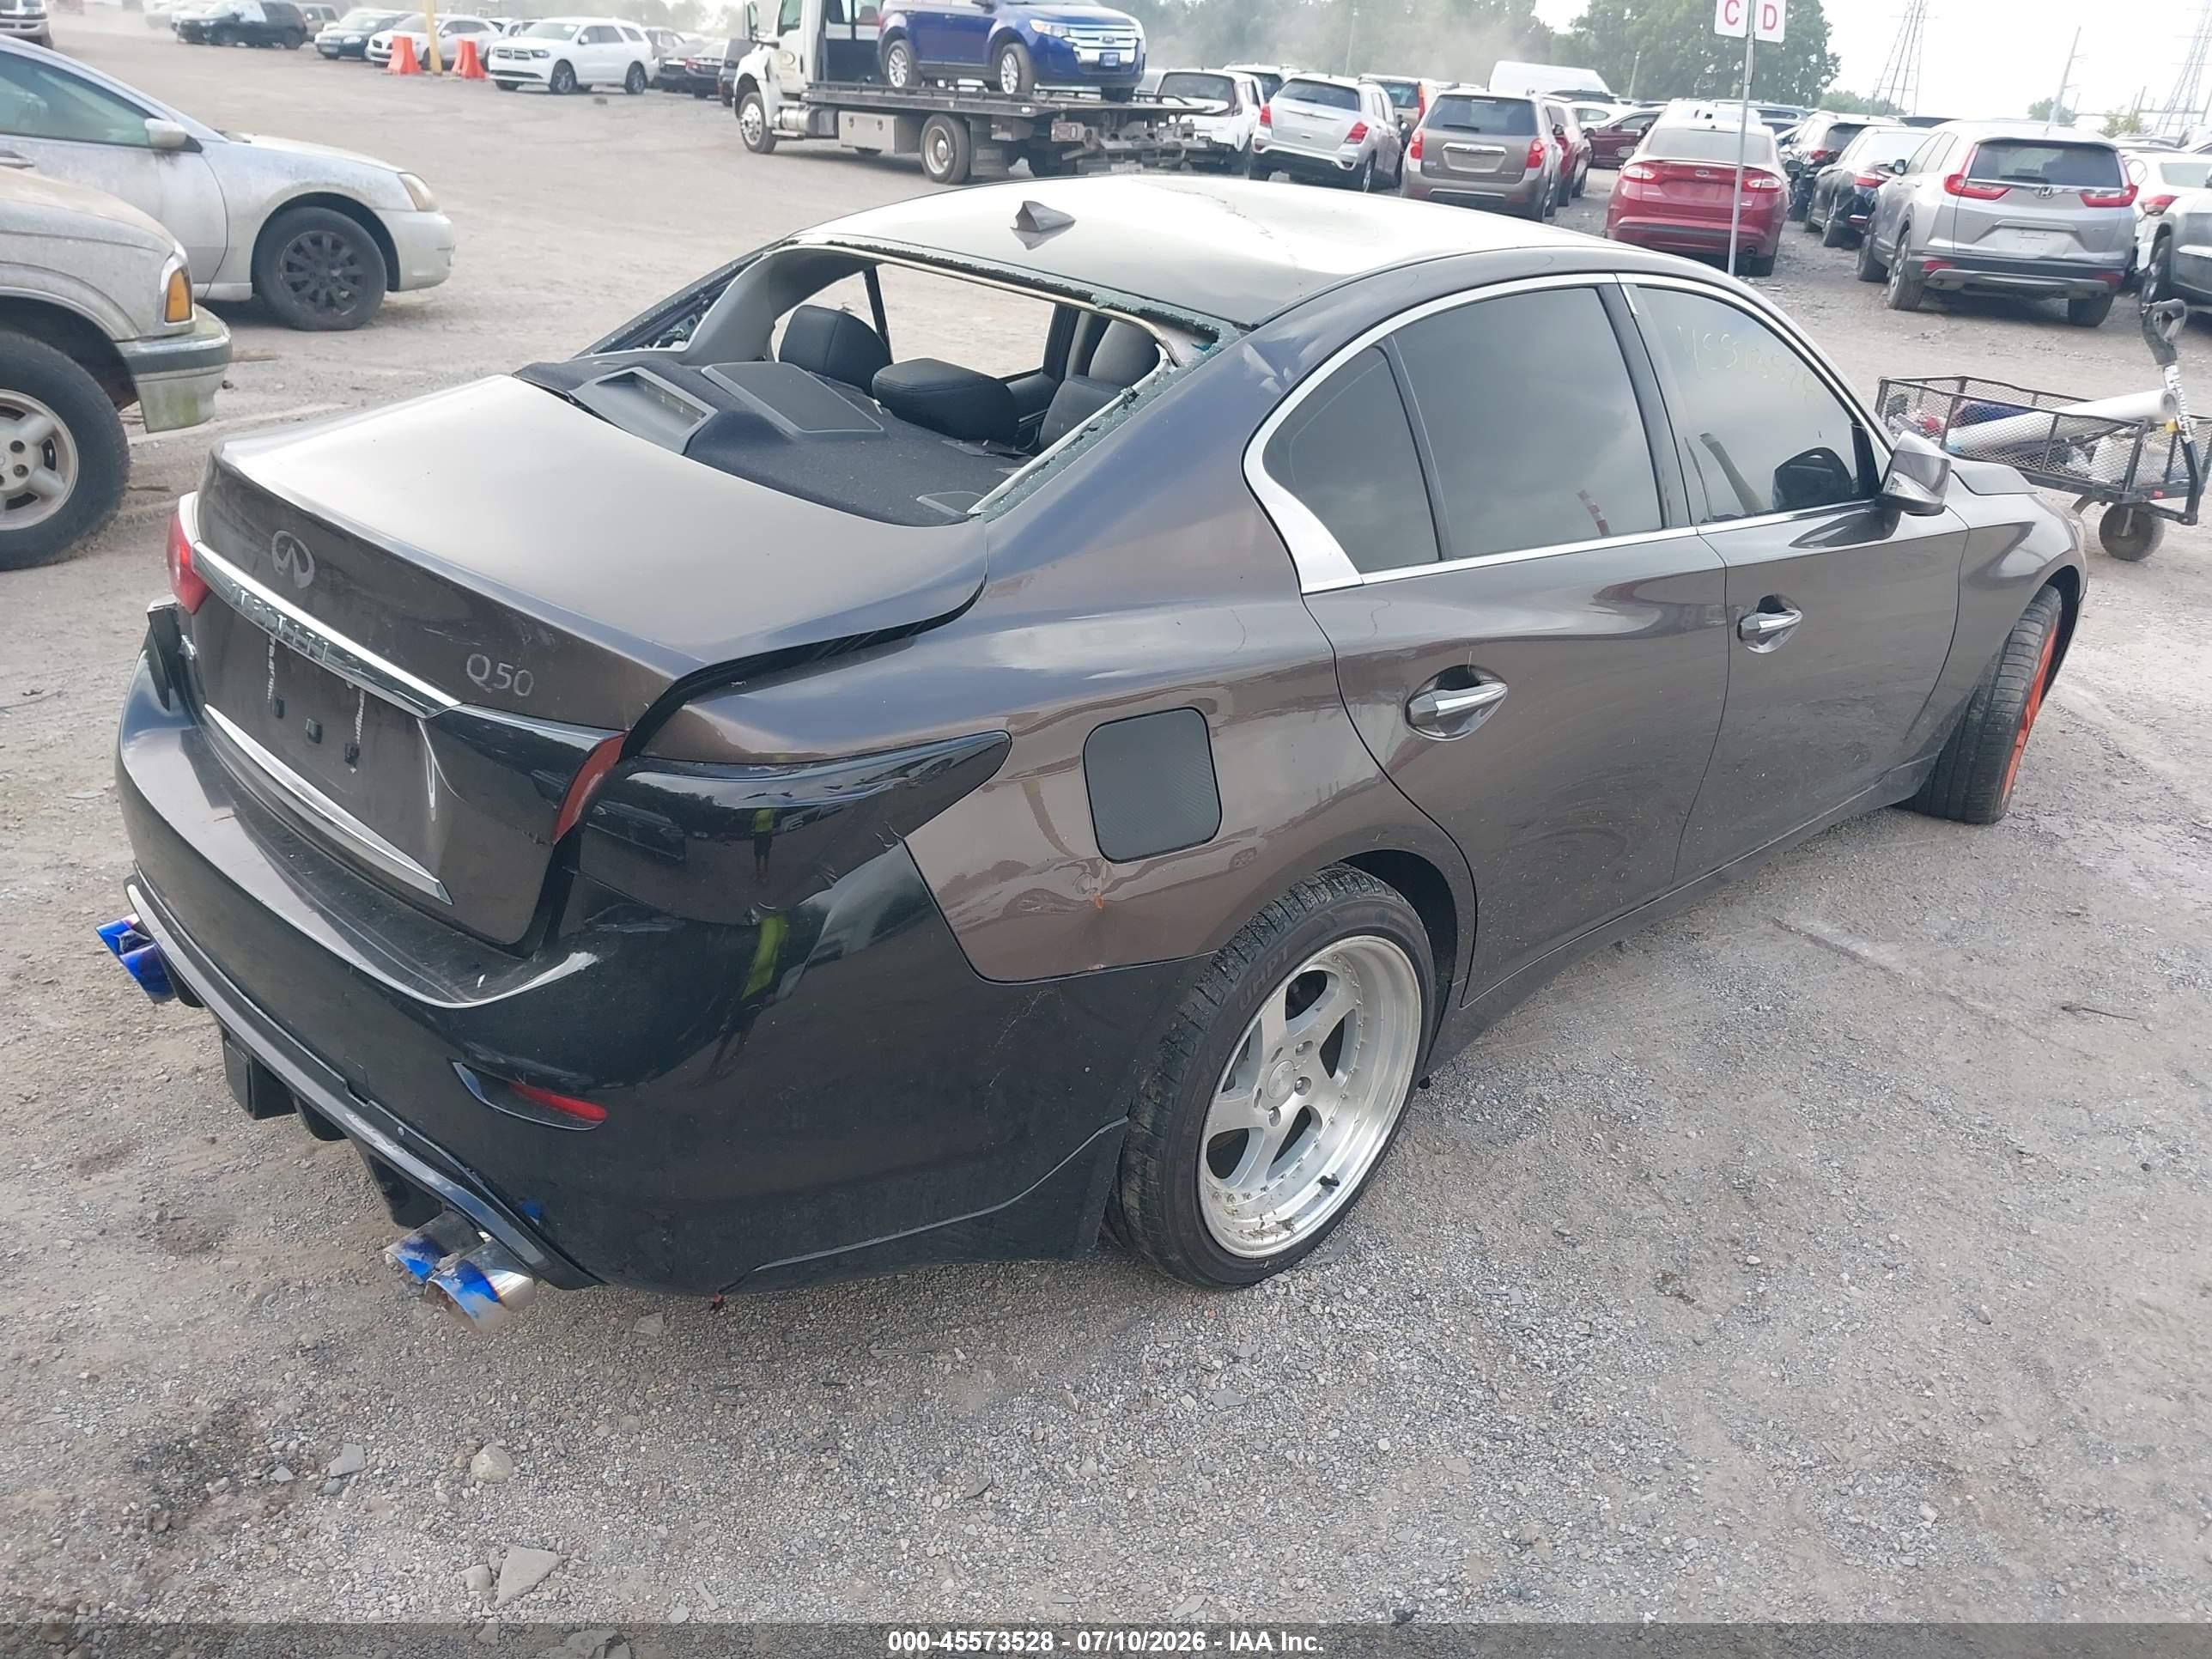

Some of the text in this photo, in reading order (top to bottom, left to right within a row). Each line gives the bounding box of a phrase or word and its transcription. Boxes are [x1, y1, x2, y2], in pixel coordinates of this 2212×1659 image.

[1724, 0, 1741, 26] C
[1762, 3, 1778, 31] D
[466, 653, 535, 697] Q50
